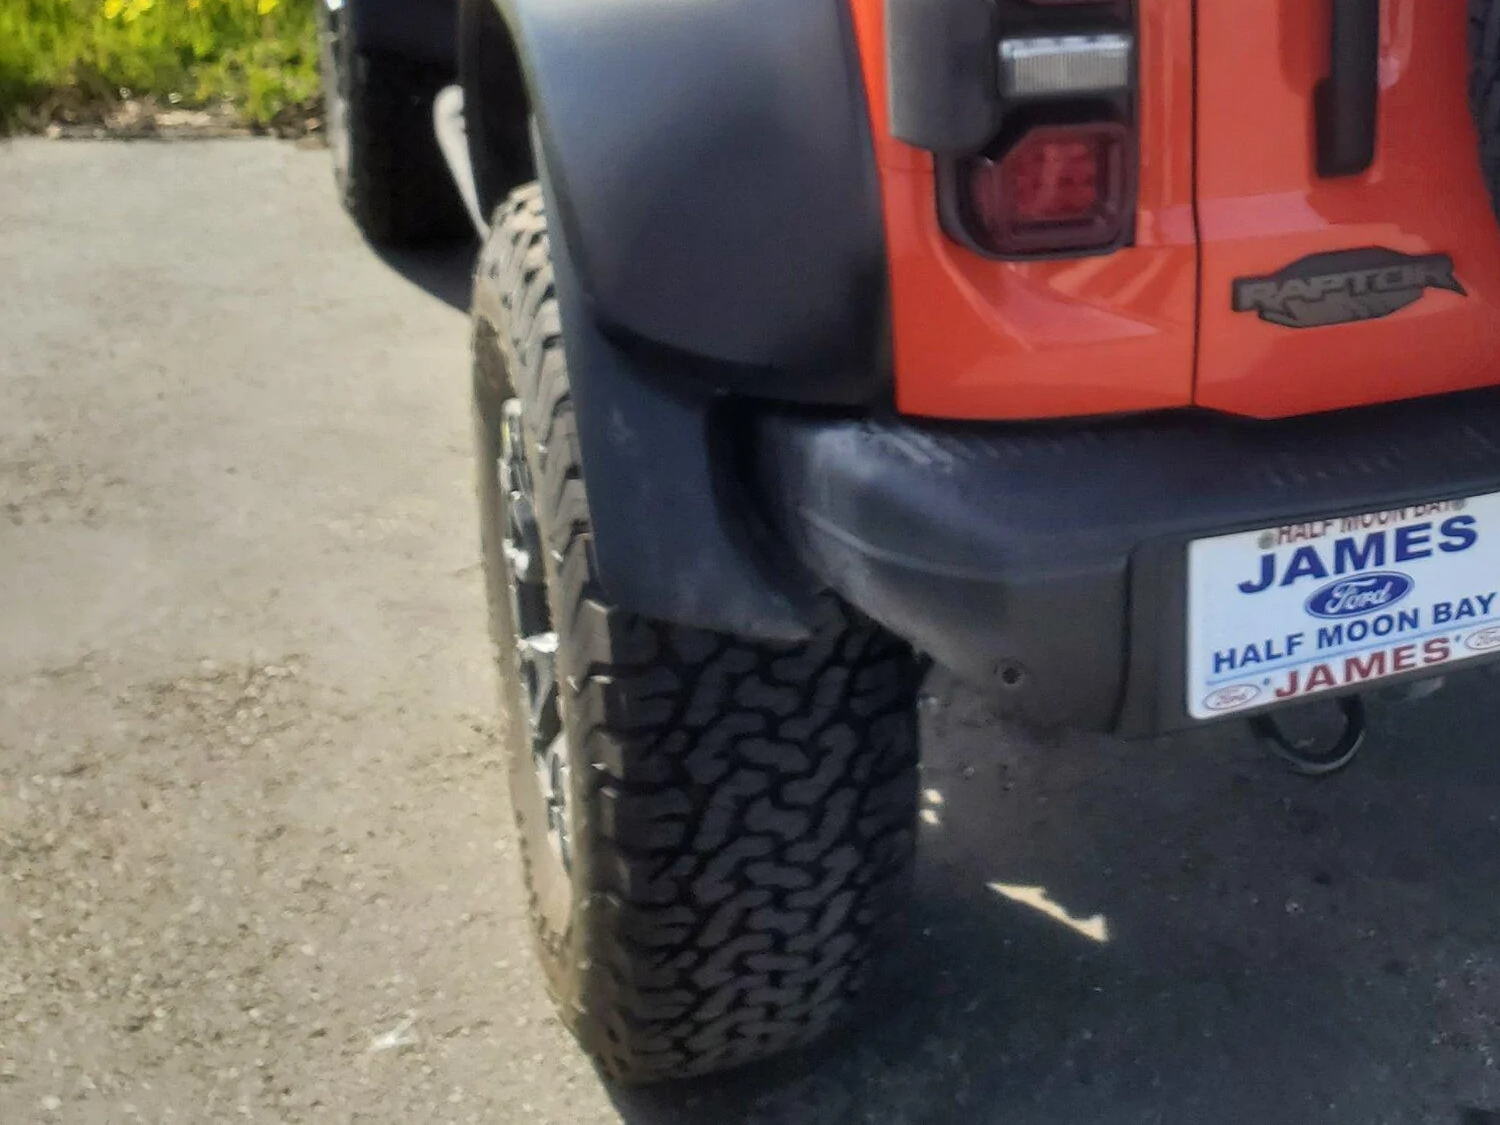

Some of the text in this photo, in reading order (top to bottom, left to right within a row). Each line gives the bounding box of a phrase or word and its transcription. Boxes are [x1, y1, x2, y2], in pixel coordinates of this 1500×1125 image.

[1237, 514, 1479, 595] JAMES
[1320, 575, 1398, 617] Ford
[1212, 592, 1498, 674] HALF MOON BAY
[1274, 637, 1451, 699] JAMES
